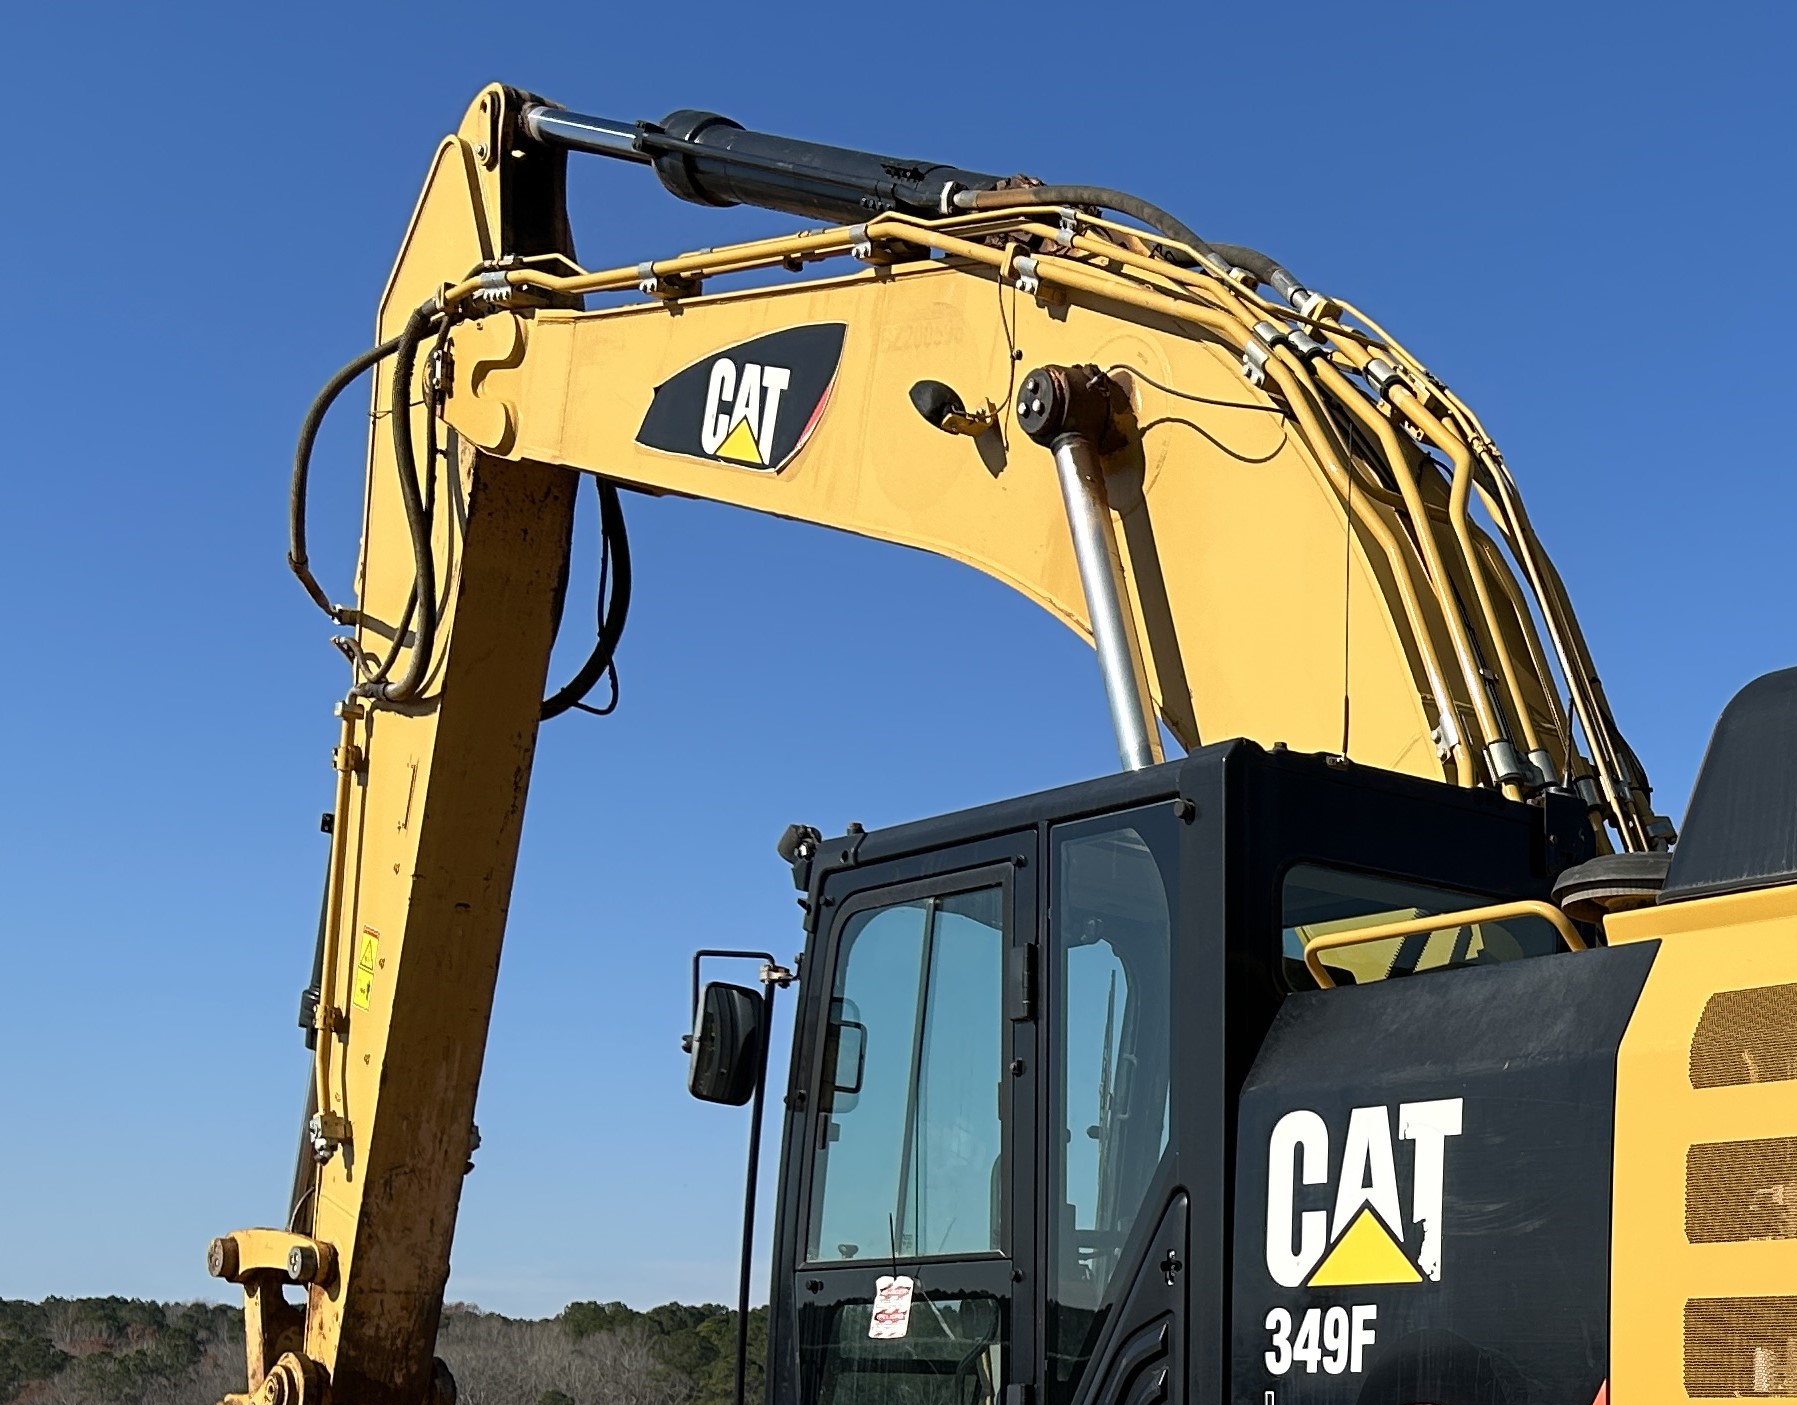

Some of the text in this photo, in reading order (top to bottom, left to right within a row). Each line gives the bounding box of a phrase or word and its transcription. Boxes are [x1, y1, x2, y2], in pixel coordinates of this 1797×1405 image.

[701, 357, 791, 465] CAT
[1266, 1098, 1463, 1287] CAT
[1264, 1303, 1377, 1376] 349F
